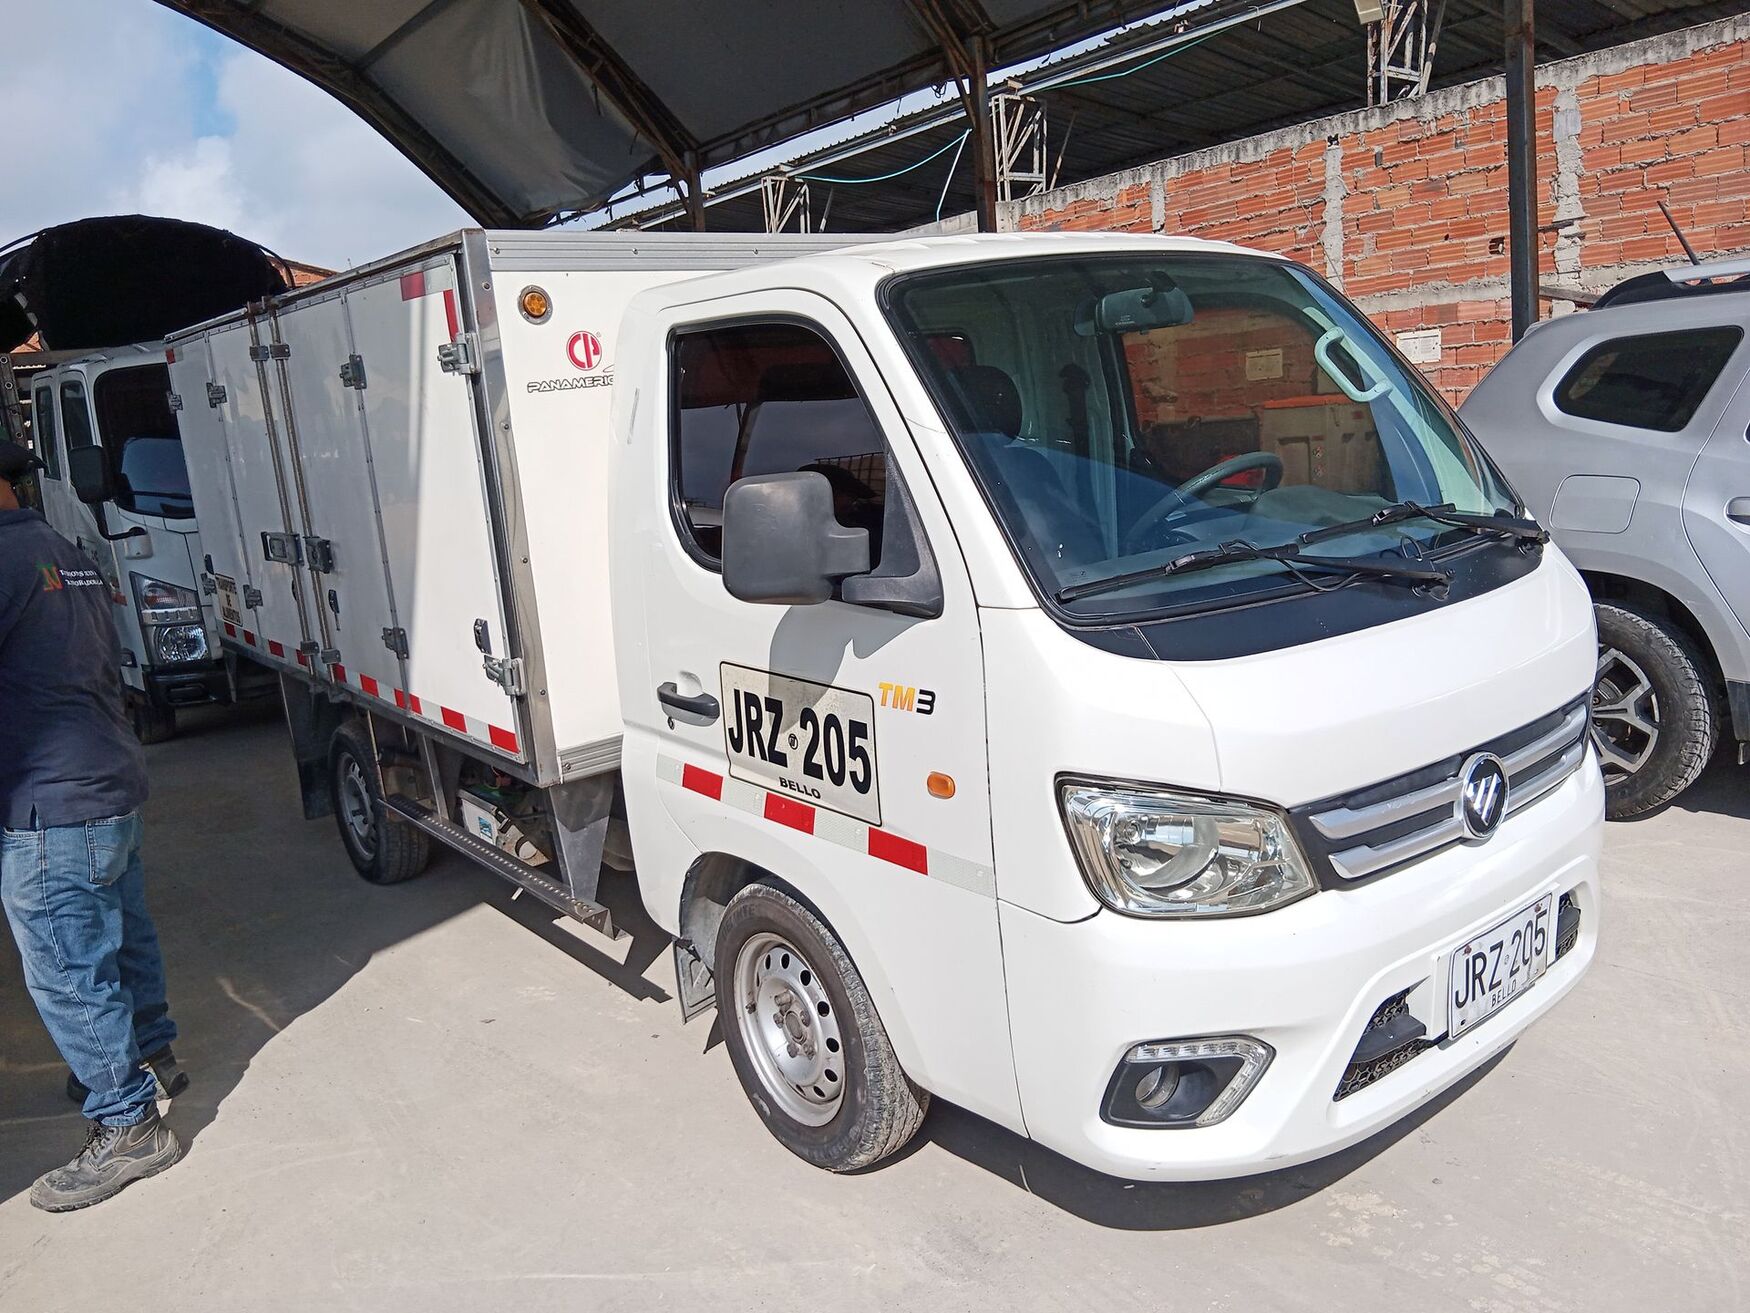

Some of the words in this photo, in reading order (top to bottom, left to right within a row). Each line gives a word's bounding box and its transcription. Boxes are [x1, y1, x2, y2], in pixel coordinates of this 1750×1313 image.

[878, 681, 936, 715] TM3
[728, 688, 788, 769] JRZ
[799, 707, 872, 795] 205
[778, 776, 822, 800] BELLO
[1454, 939, 1504, 1010] JRZ
[1509, 908, 1548, 979] 205
[1491, 979, 1517, 1008] BELLO
